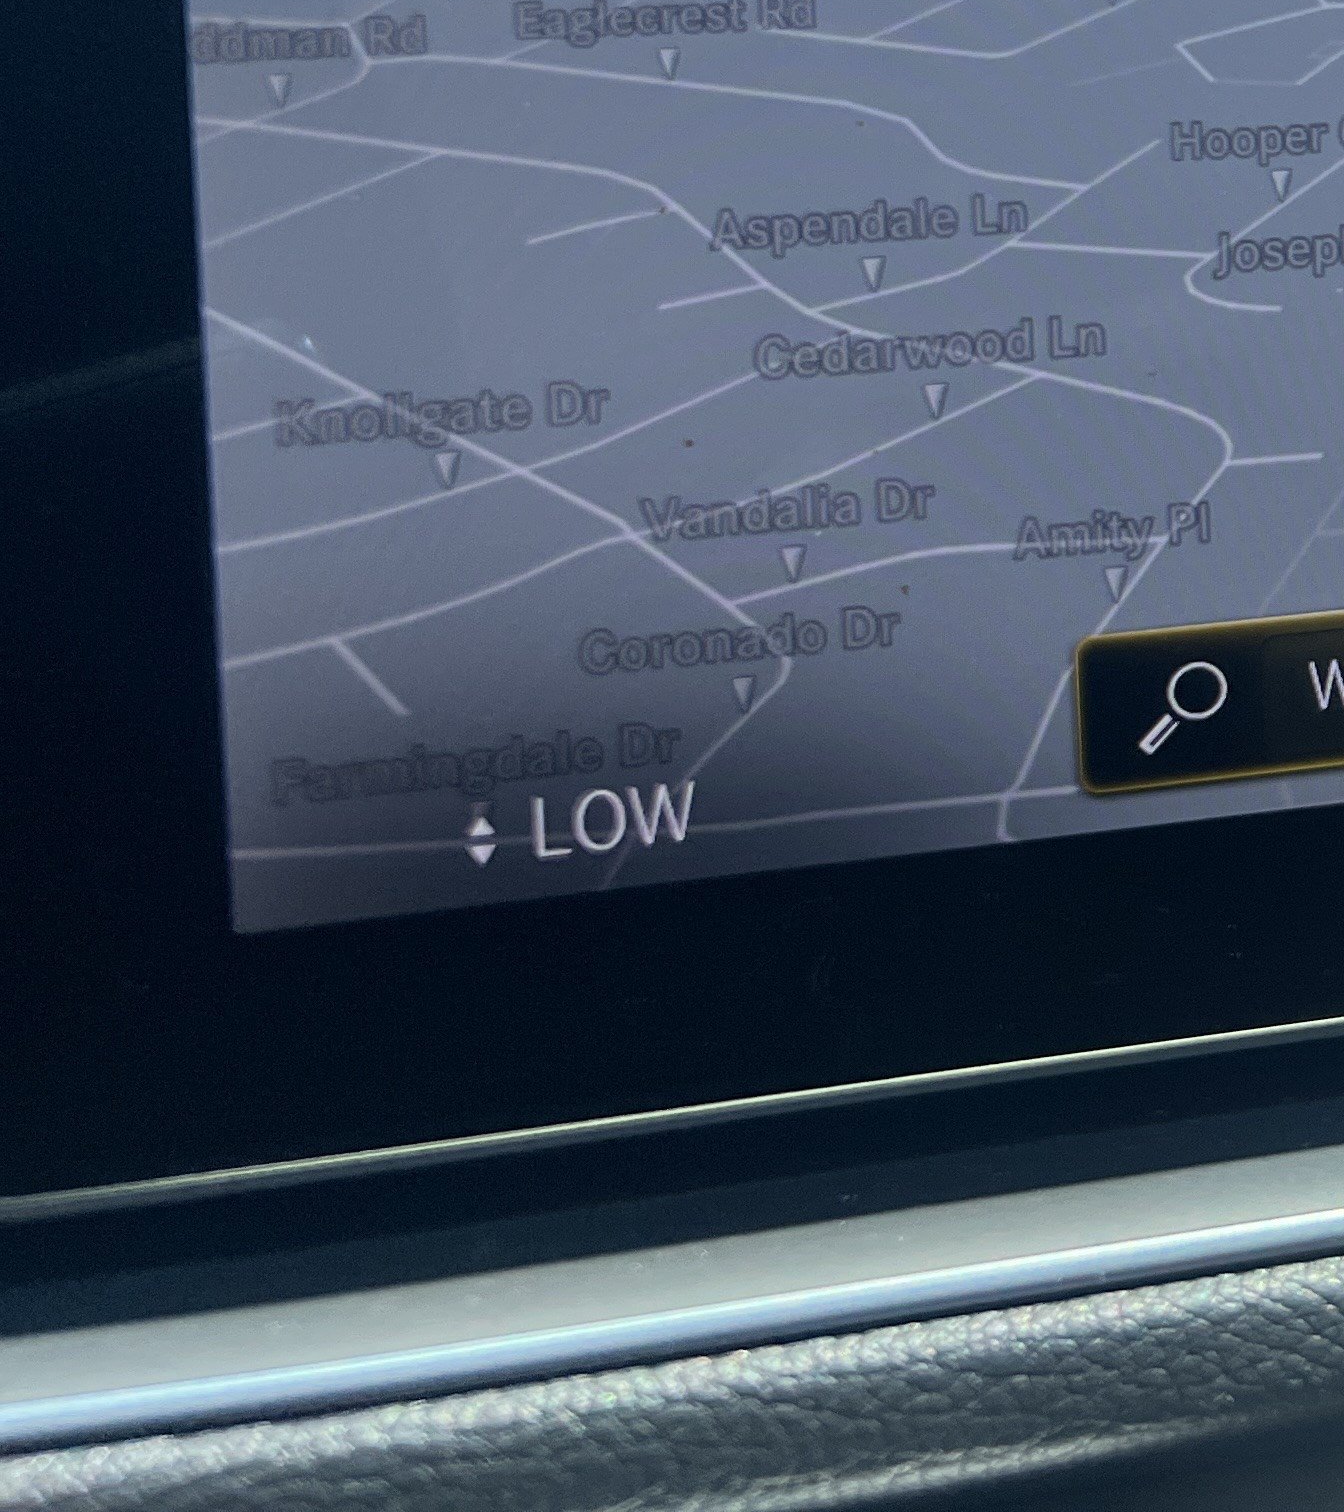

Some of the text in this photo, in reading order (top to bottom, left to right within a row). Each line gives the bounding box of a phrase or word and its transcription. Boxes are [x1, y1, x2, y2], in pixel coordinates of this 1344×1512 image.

[364, 13, 428, 56] Rd
[1169, 121, 1328, 165] Hooper
[710, 193, 1030, 258] Aspendale Ln
[753, 314, 1108, 379] Cedarwood Ln
[271, 380, 611, 449] Knollgate Dr
[637, 477, 936, 541] Vandalia Dr
[1011, 500, 1211, 562] Amity Pl
[578, 605, 901, 675] Coronado Dr
[269, 722, 683, 806] Farmingdale Dr
[530, 780, 695, 860] LOW
